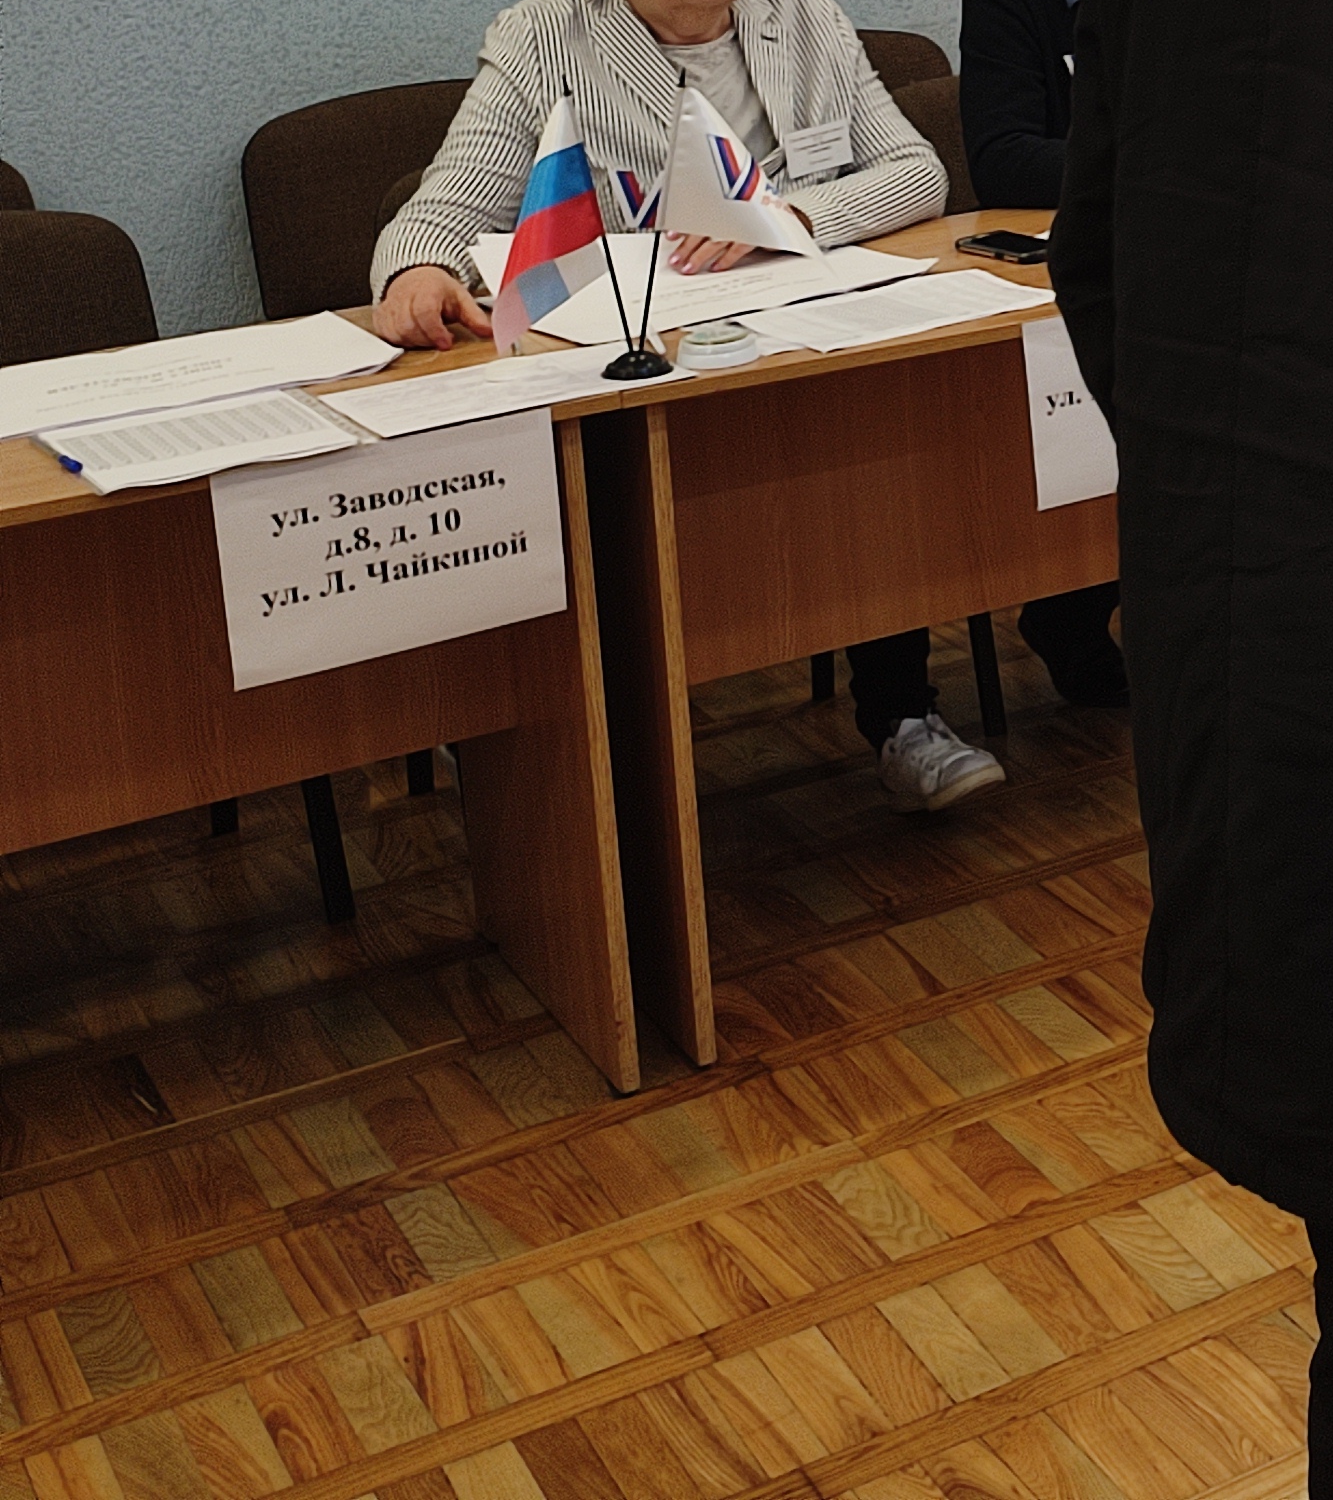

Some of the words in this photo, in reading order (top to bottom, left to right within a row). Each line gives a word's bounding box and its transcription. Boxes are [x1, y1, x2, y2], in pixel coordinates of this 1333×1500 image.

[1046, 390, 1082, 416] ул.
[271, 507, 320, 537] ул.
[328, 469, 506, 518] Заводская,
[325, 526, 381, 560] д.8,
[389, 524, 417, 547] д.
[429, 508, 461, 536] 10
[261, 586, 310, 617] ул.
[319, 569, 356, 598] Л.
[366, 530, 528, 584] Чайкиной
